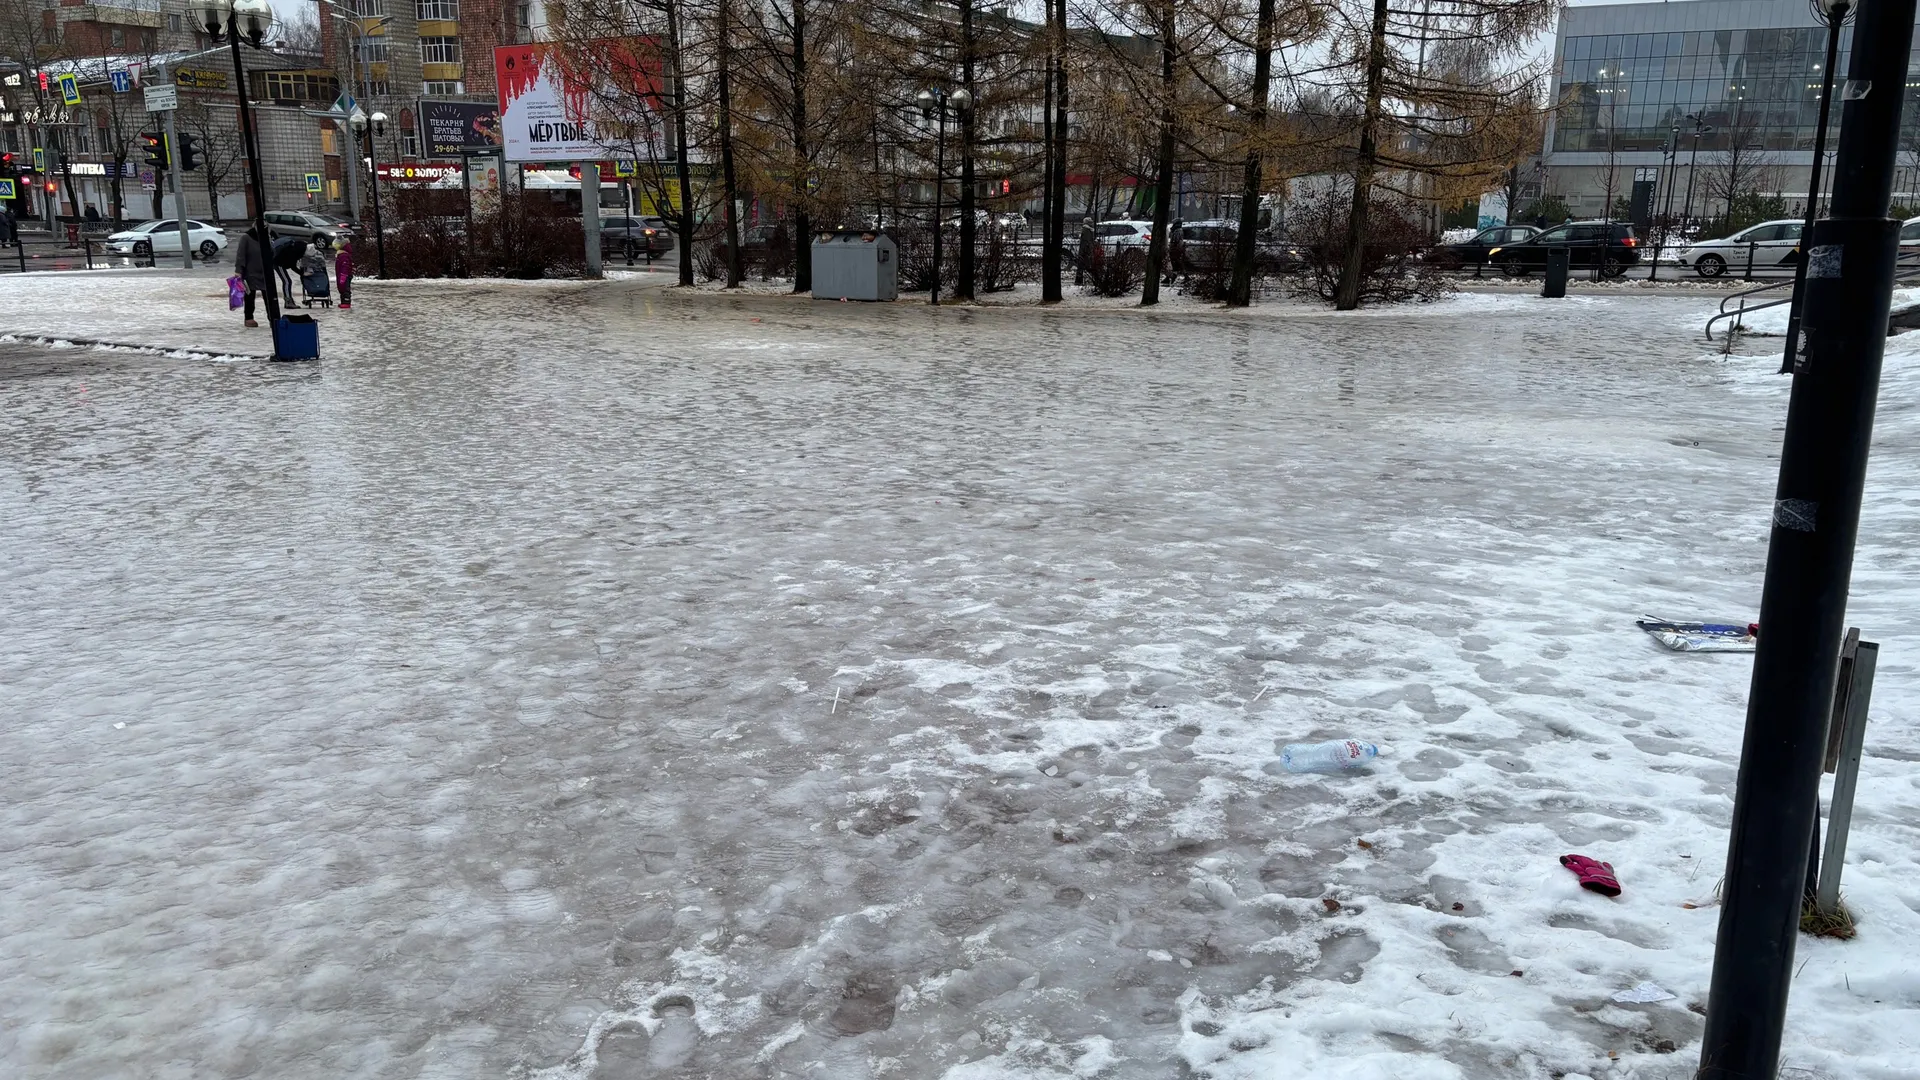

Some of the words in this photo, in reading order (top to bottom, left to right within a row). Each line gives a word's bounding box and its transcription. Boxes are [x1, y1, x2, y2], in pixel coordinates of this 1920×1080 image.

[430, 119, 464, 127] ПЕКАРНЯ
[434, 127, 462, 135] БРАТЬЕВ
[529, 120, 588, 142] МЁРТВЫЕ
[71, 163, 106, 175] АПТЕКА
